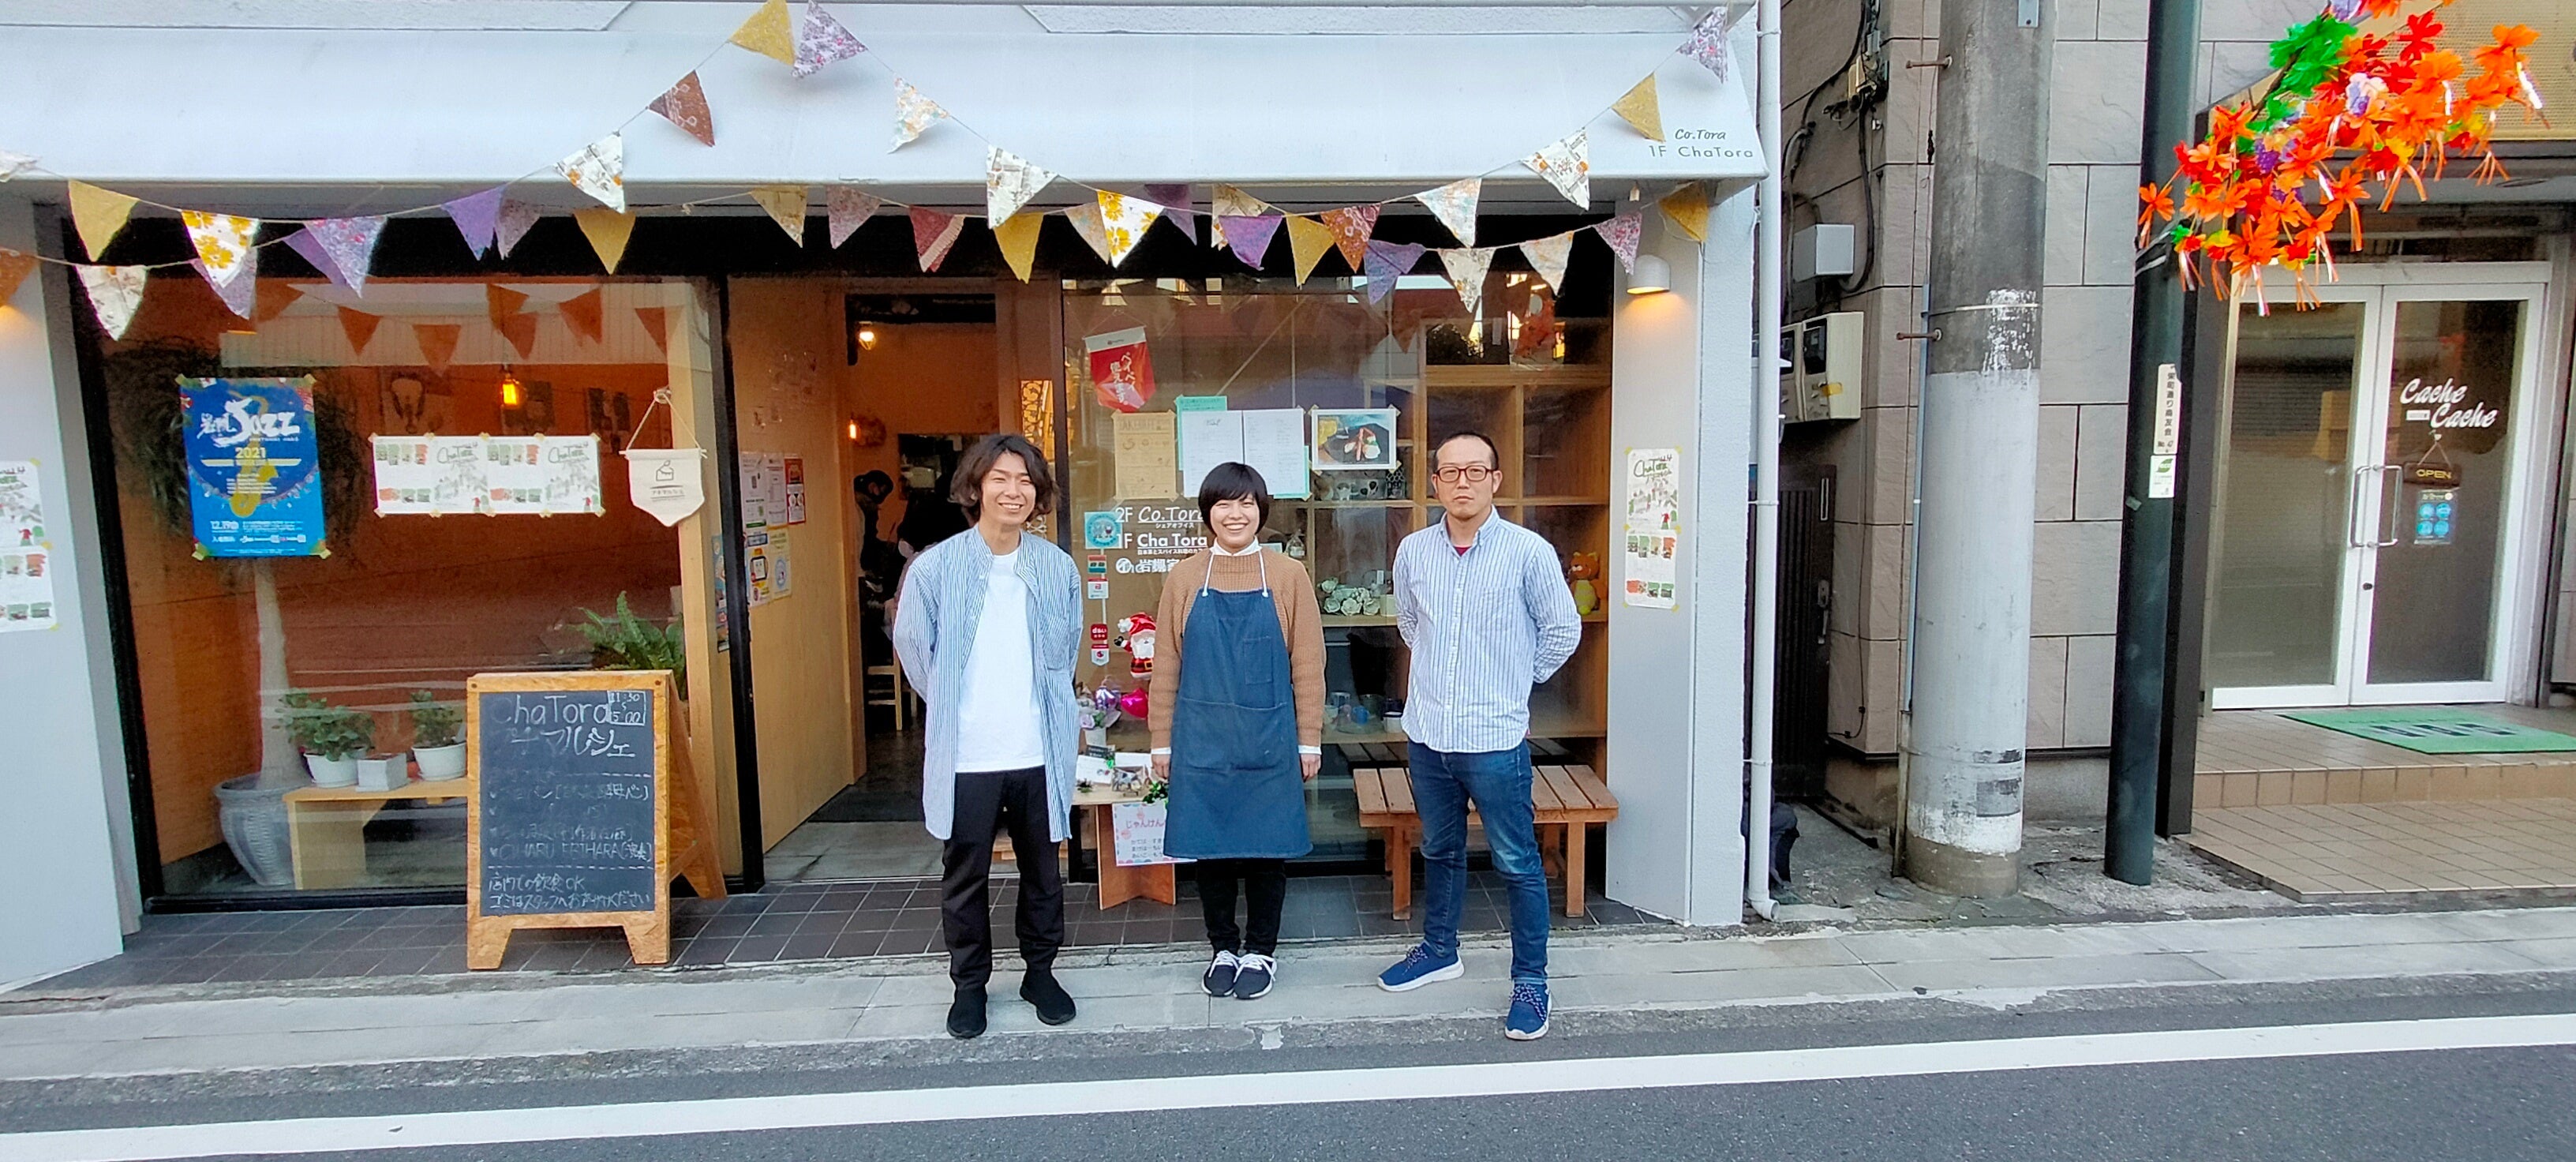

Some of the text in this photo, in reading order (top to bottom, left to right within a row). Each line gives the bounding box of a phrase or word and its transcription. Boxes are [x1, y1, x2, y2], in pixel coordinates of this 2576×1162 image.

[1675, 129, 1727, 140] Co.Tora
[1649, 145, 1754, 158] 1F ChaTora
[2400, 378, 2468, 404] Cache
[2430, 402, 2499, 428] Cache
[234, 447, 267, 459] 2021
[2416, 469, 2452, 480] OPEN
[1115, 506, 1133, 523] 2F
[1136, 533, 1169, 547] Cha
[1171, 533, 1208, 547] Tora
